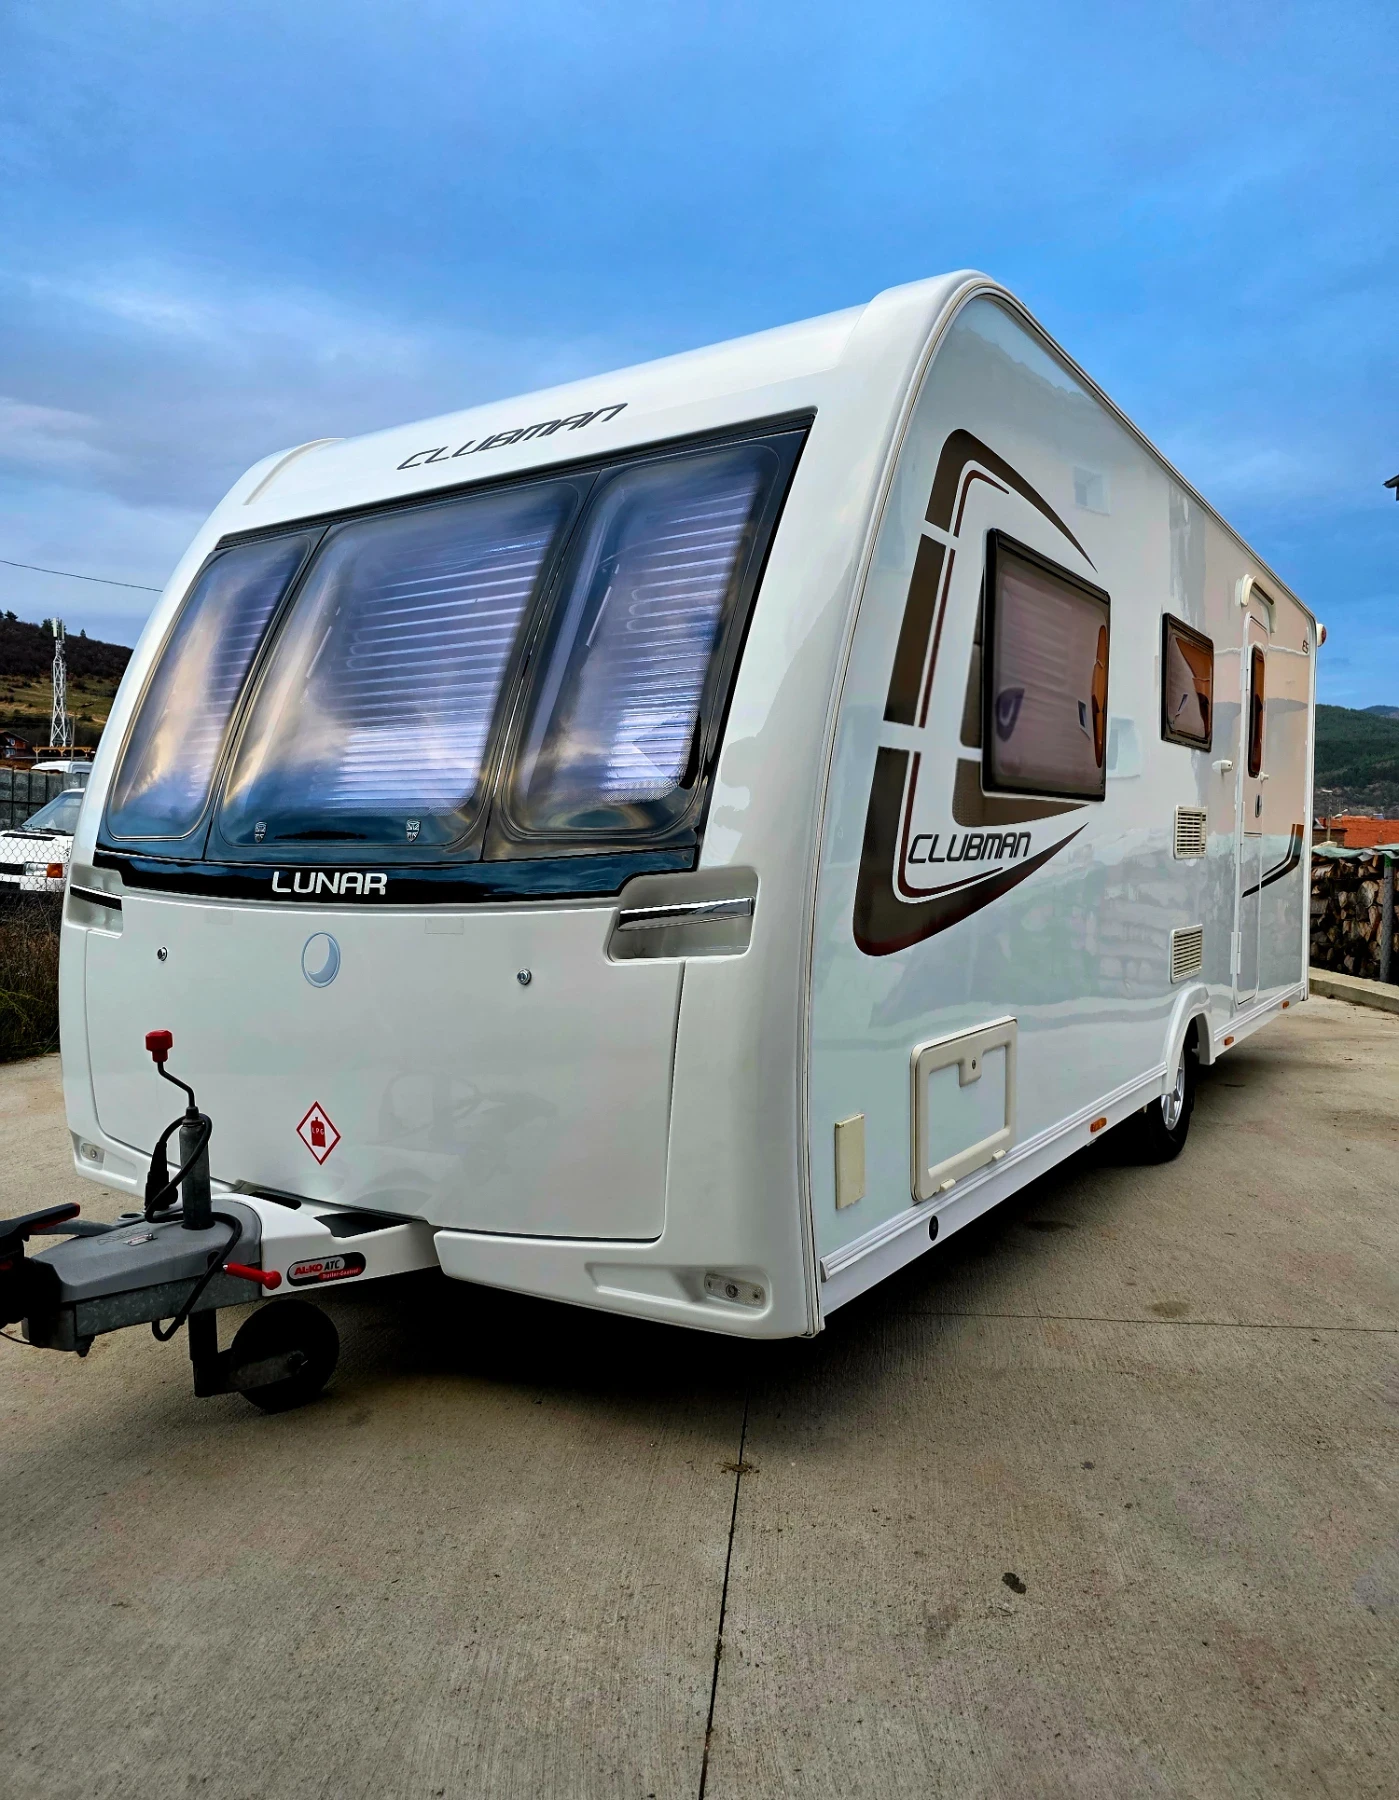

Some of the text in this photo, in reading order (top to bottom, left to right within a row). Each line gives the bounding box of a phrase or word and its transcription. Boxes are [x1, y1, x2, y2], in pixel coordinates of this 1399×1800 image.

[396, 402, 629, 471] CLUBMAN
[907, 831, 1032, 864] CLUBMAN
[271, 871, 388, 896] LUNAR
[324, 1259, 341, 1272] ATC
